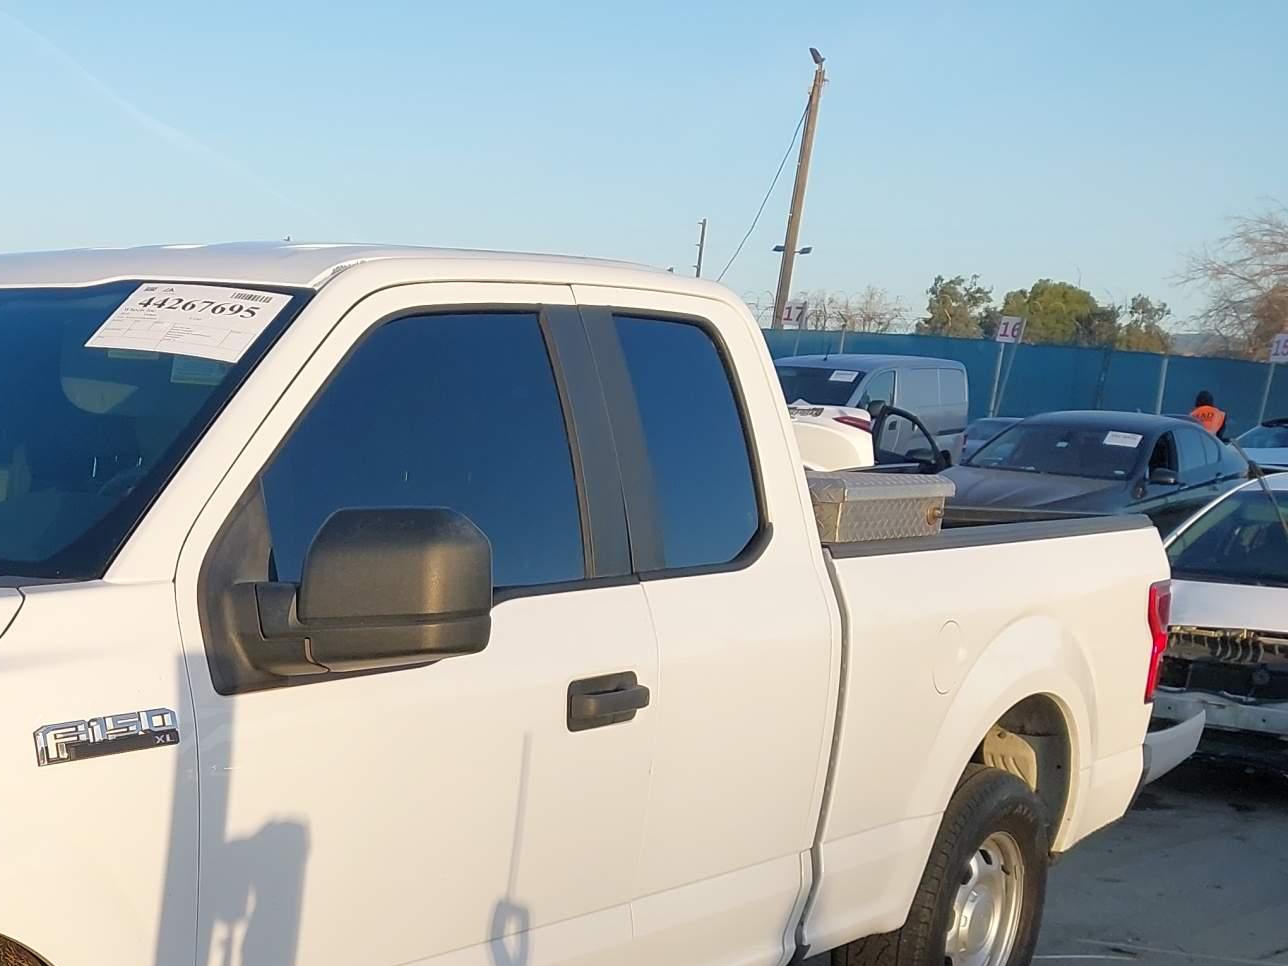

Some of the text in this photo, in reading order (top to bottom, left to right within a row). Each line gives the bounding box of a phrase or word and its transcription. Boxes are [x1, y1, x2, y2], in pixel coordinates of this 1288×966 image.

[137, 295, 261, 319] 44267695
[782, 306, 804, 322] 17
[999, 321, 1022, 338] 16
[154, 733, 176, 745] XL
